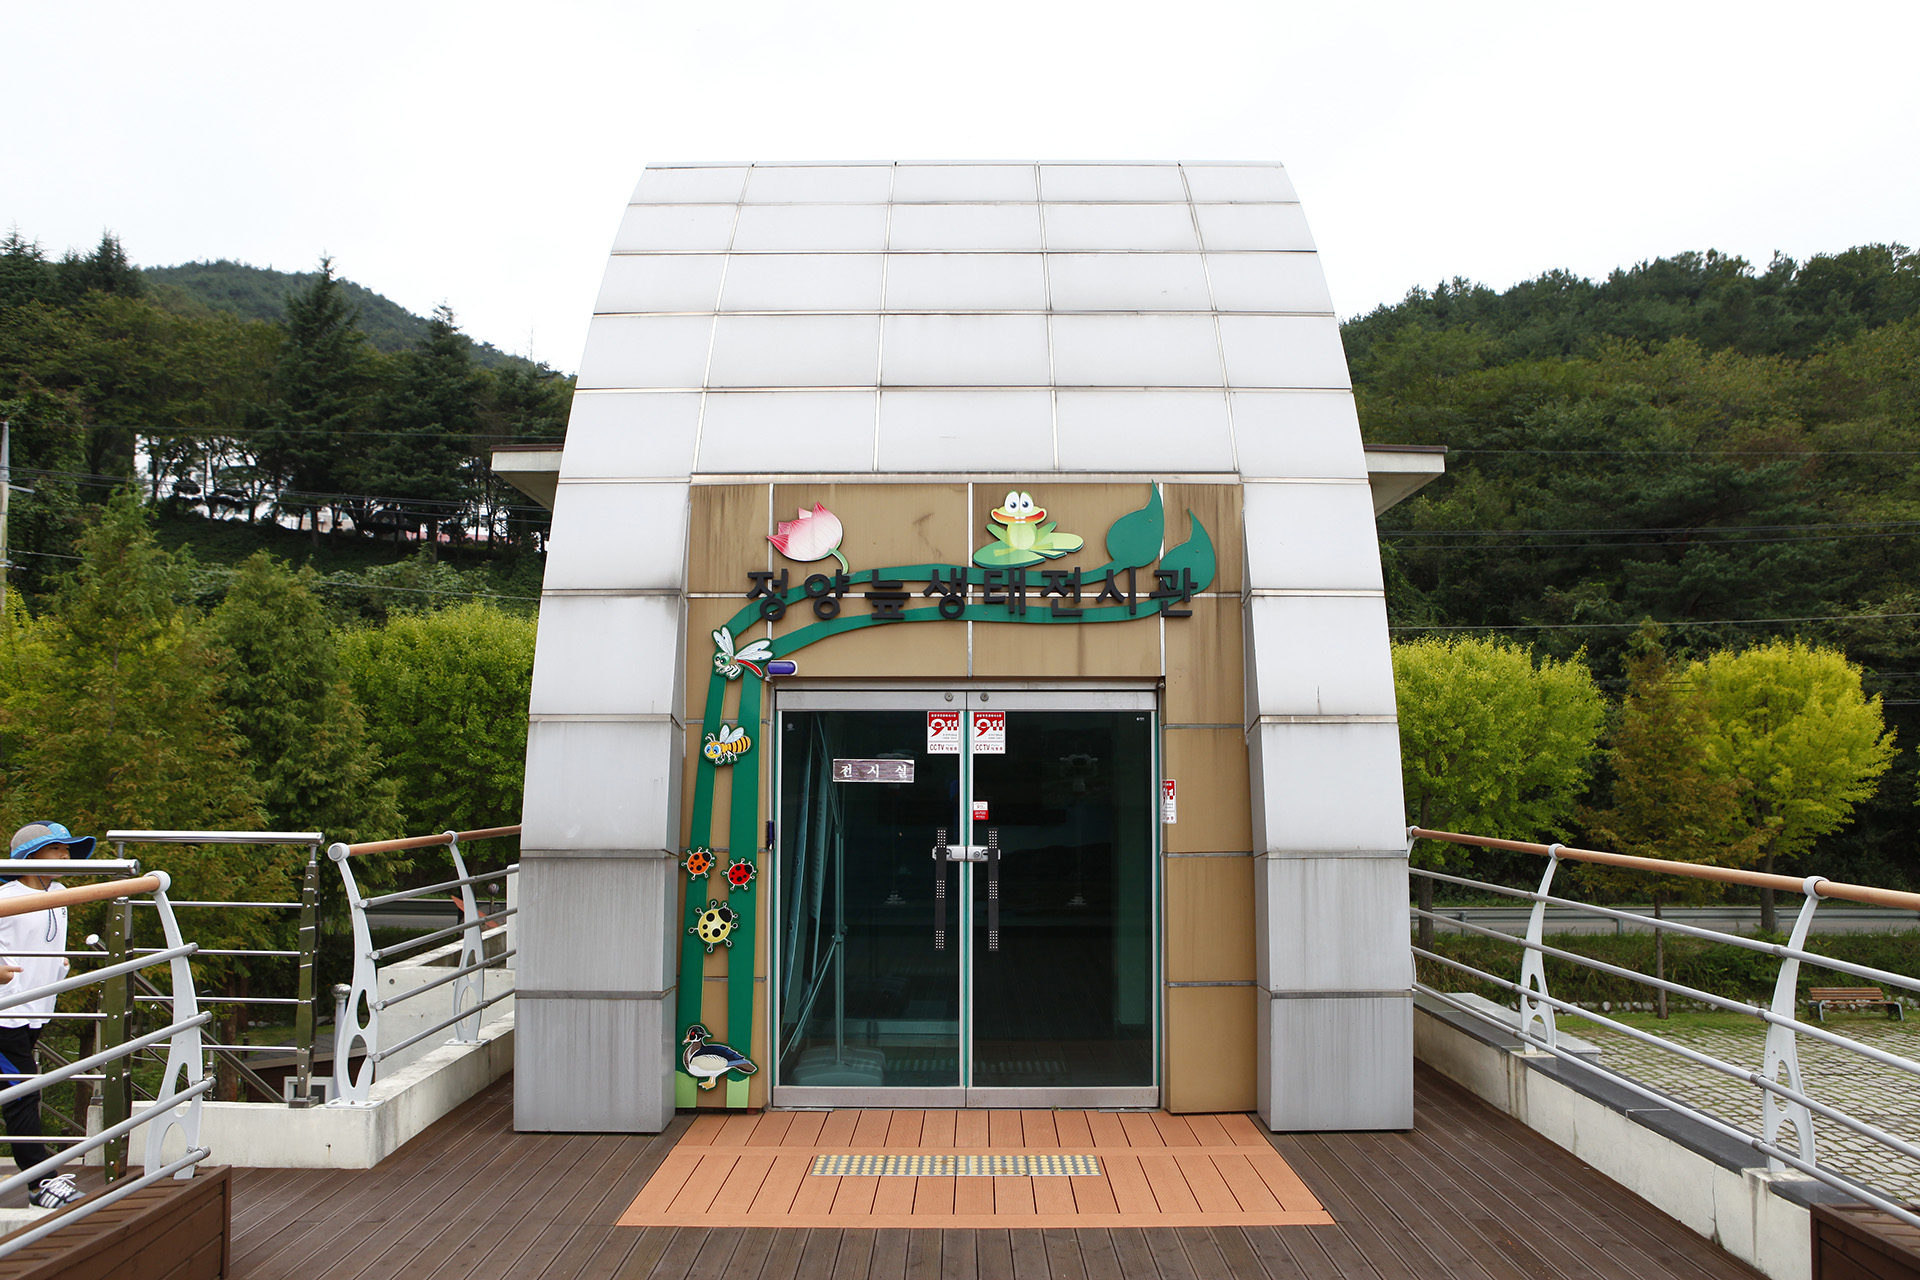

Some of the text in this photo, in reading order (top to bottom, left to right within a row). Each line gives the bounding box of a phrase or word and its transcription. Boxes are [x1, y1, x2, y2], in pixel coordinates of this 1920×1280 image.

[746, 566, 1198, 621] 정양늪생태전시관
[930, 718, 958, 737] 911
[976, 718, 1003, 737] 911
[929, 743, 945, 751] CCTV
[975, 743, 990, 751] CCTV
